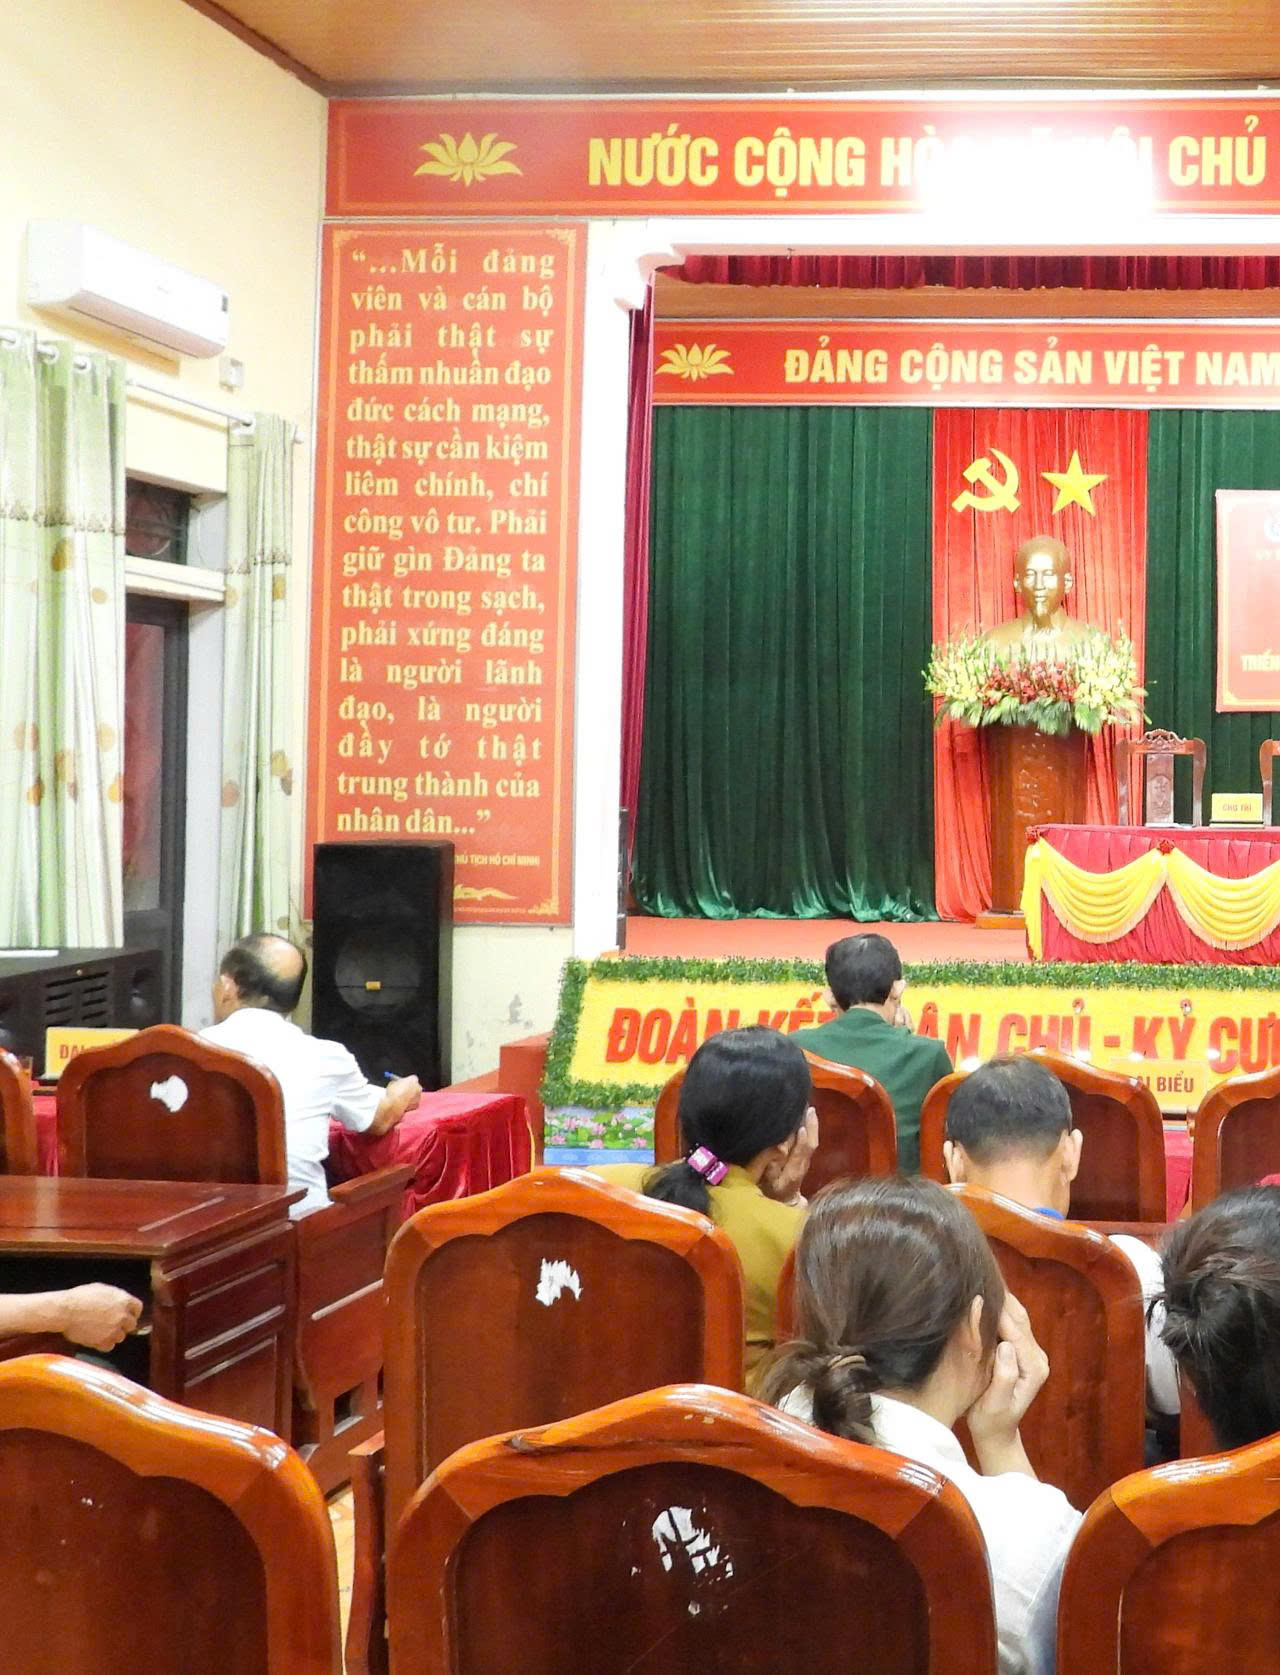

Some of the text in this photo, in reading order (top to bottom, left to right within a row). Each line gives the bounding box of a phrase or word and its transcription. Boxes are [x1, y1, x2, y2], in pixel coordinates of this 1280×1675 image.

[589, 124, 718, 187] NƯỚC
[735, 129, 865, 196] CỘNG
[1169, 115, 1266, 186] CHỦ
[482, 248, 555, 280] đảng
[351, 284, 553, 317] viên và cán bộ
[349, 322, 554, 355] phải thật sự
[348, 345, 552, 392] thấm nhuần đạo
[785, 336, 888, 384] ĐẢNG
[900, 342, 1001, 391] CỘNG
[1014, 336, 1094, 385] SẢN
[1104, 342, 1184, 392] VIỆT
[347, 396, 550, 429] đức cách mạng,
[346, 427, 548, 466] thật sự cần kiệm
[345, 470, 549, 502] liêm chính, chí
[344, 507, 547, 540] công vô tư. Phải
[342, 545, 546, 578] giữ gìn Đảng ta
[342, 582, 545, 616] thật trong sạch,
[341, 620, 544, 654] phải xứng đáng
[340, 657, 543, 690] là người lãnh
[338, 695, 542, 729] đạo, là người
[338, 718, 542, 767] đầy tớ thật
[337, 771, 541, 802] trung thành của
[337, 807, 402, 836] nhân
[1132, 999, 1196, 1060] KỶ
[1157, 1071, 1194, 1093] BIỂU
